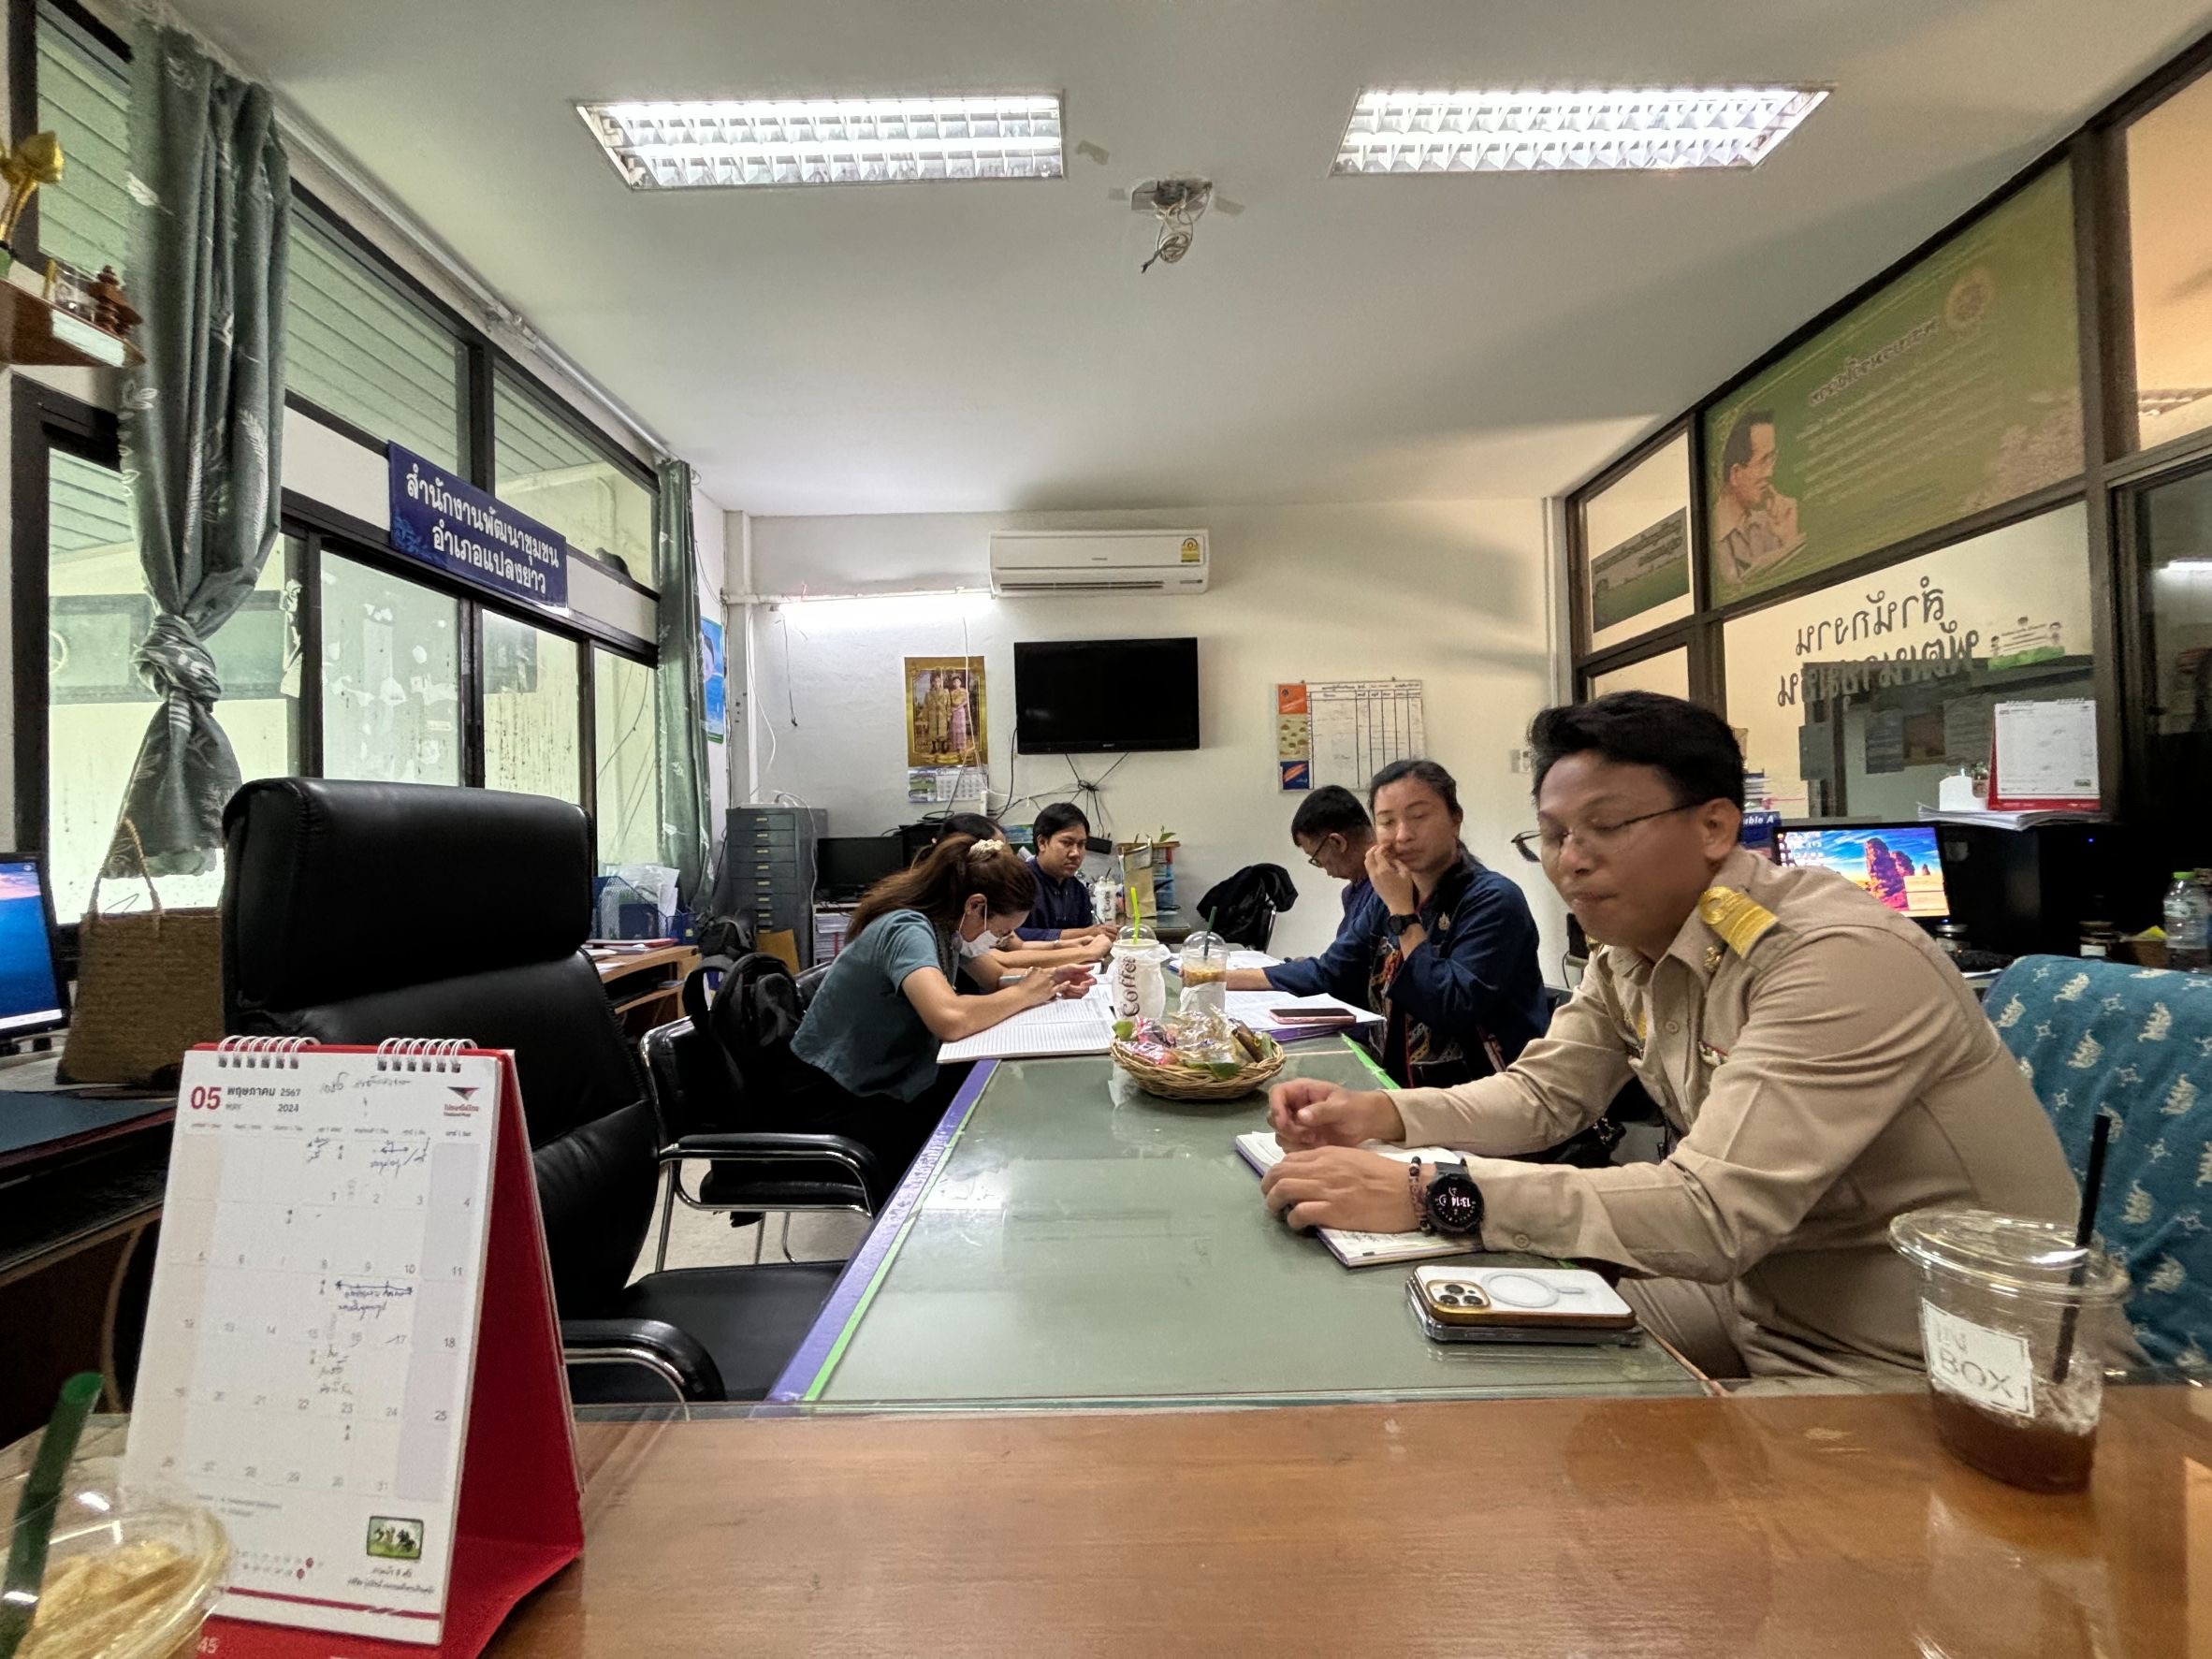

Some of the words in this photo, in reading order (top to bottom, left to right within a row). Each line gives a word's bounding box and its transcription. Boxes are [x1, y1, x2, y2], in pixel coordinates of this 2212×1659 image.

[406, 463, 559, 569] สำนักงานพัฒนาชุมชน
[432, 519, 546, 594] อำเภอแปลงยาว
[226, 1086, 276, 1098] พฤษภาคม
[280, 1088, 301, 1097] 2567
[190, 1086, 222, 1111] 05
[277, 1103, 299, 1113] 2024
[404, 1264, 415, 1273] 10
[453, 1267, 462, 1276] 11
[444, 1338, 455, 1347] 18
[435, 1410, 447, 1420] 25
